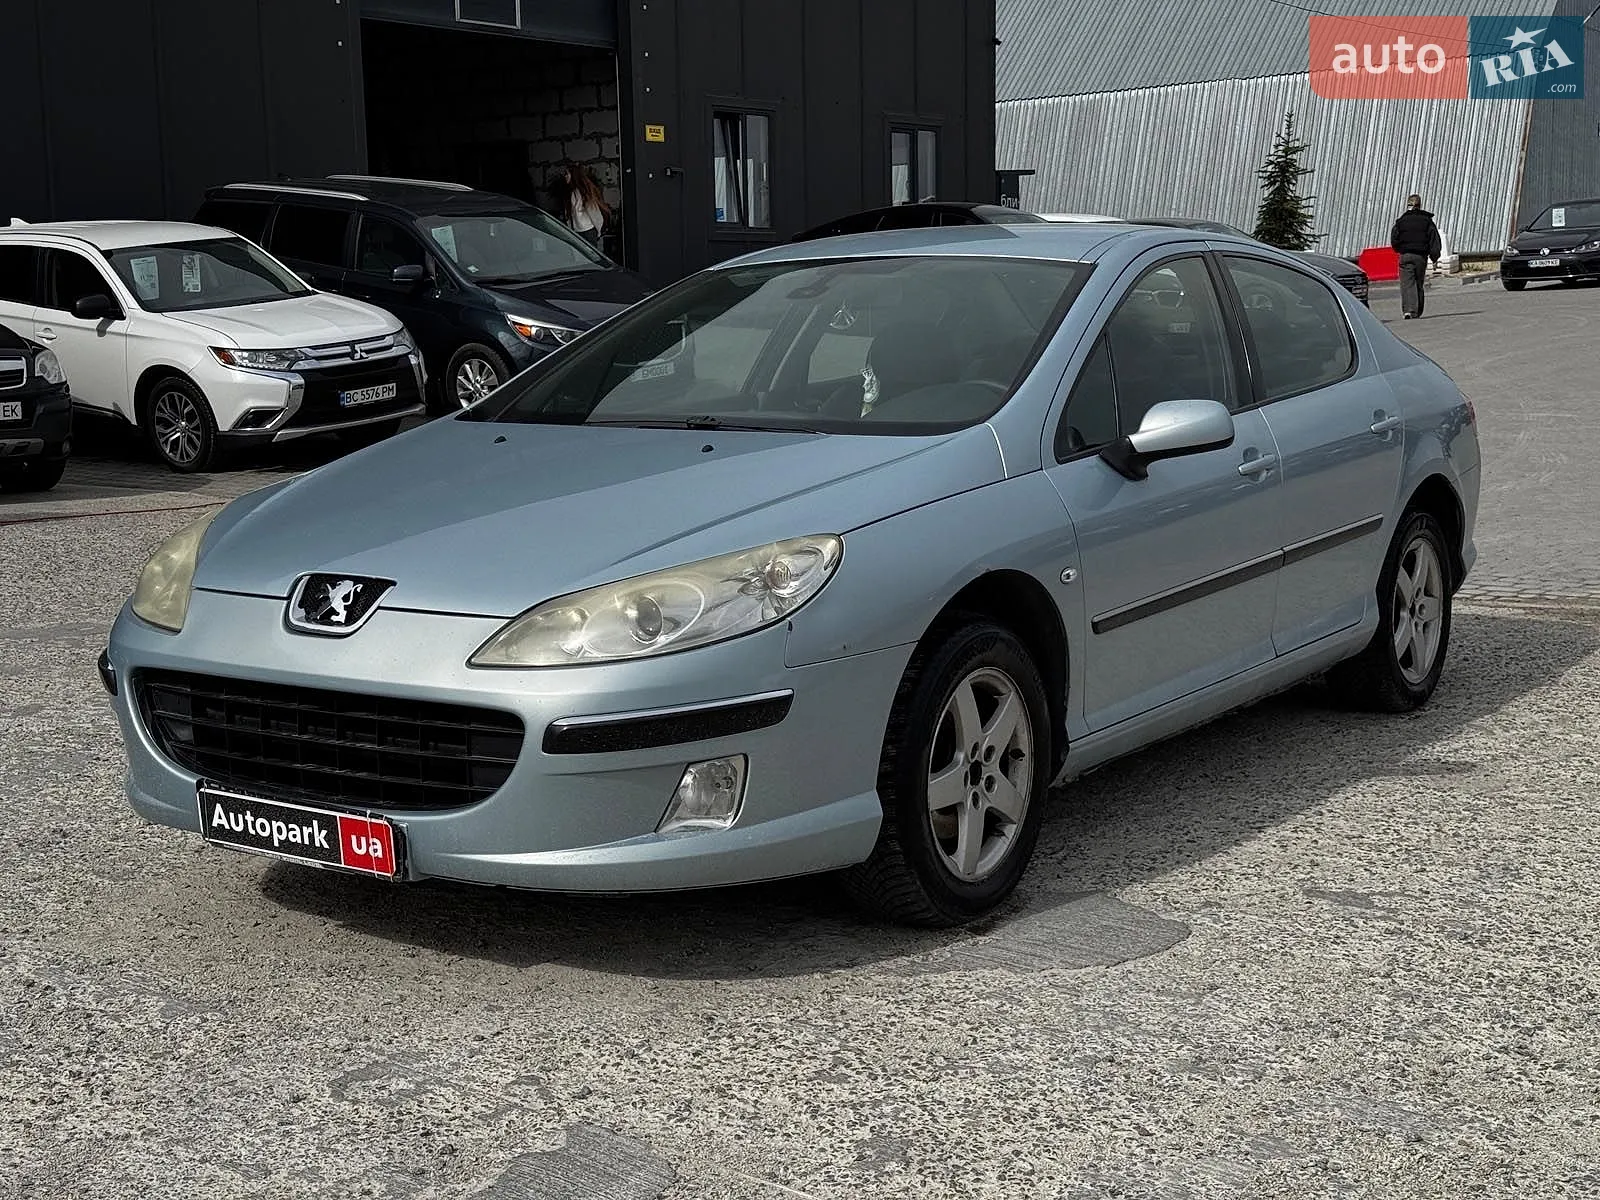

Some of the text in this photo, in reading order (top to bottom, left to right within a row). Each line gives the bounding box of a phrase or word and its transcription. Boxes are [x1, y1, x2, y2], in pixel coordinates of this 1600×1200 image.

[345, 391, 359, 404] BC
[360, 387, 380, 401] 5576
[381, 385, 395, 397] PM
[2, 404, 19, 417] EK
[211, 802, 330, 849] Autopark
[351, 834, 383, 859] ua
